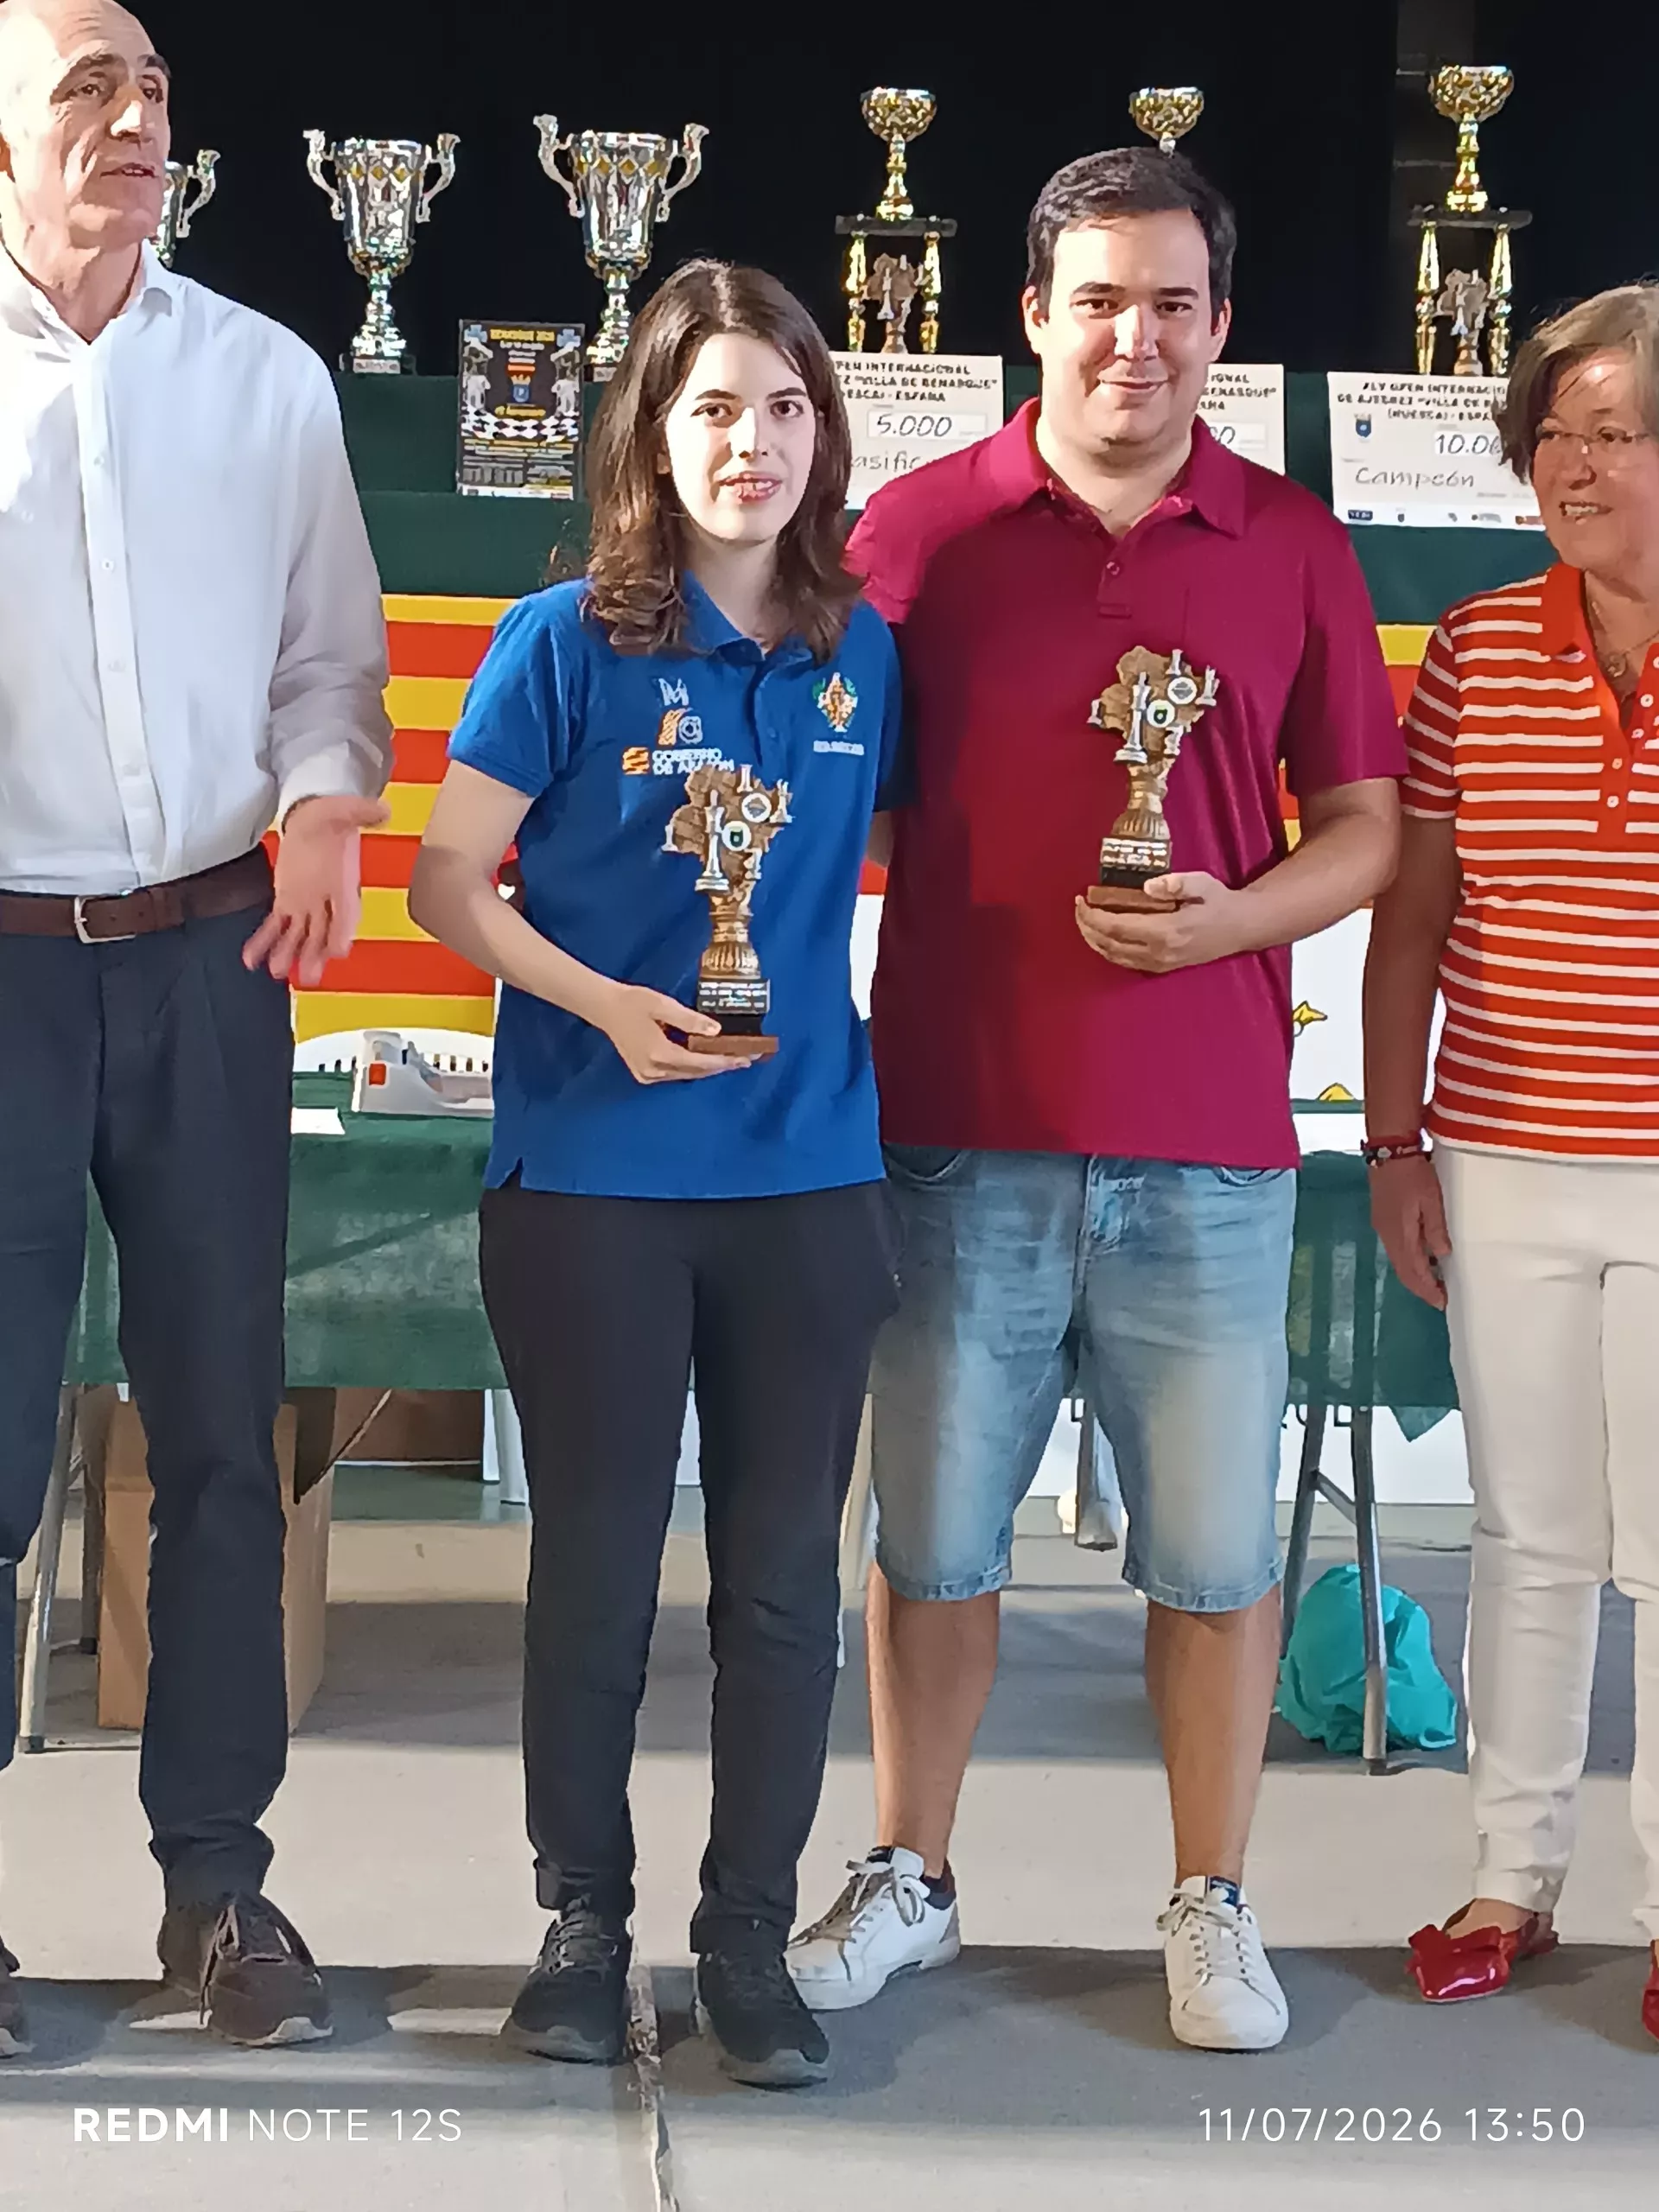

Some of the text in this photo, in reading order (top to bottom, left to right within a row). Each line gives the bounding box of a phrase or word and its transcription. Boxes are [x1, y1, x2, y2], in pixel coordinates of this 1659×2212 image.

[835, 359, 862, 372] PEN
[876, 412, 953, 437] 5.000
[850, 449, 922, 473] asific
